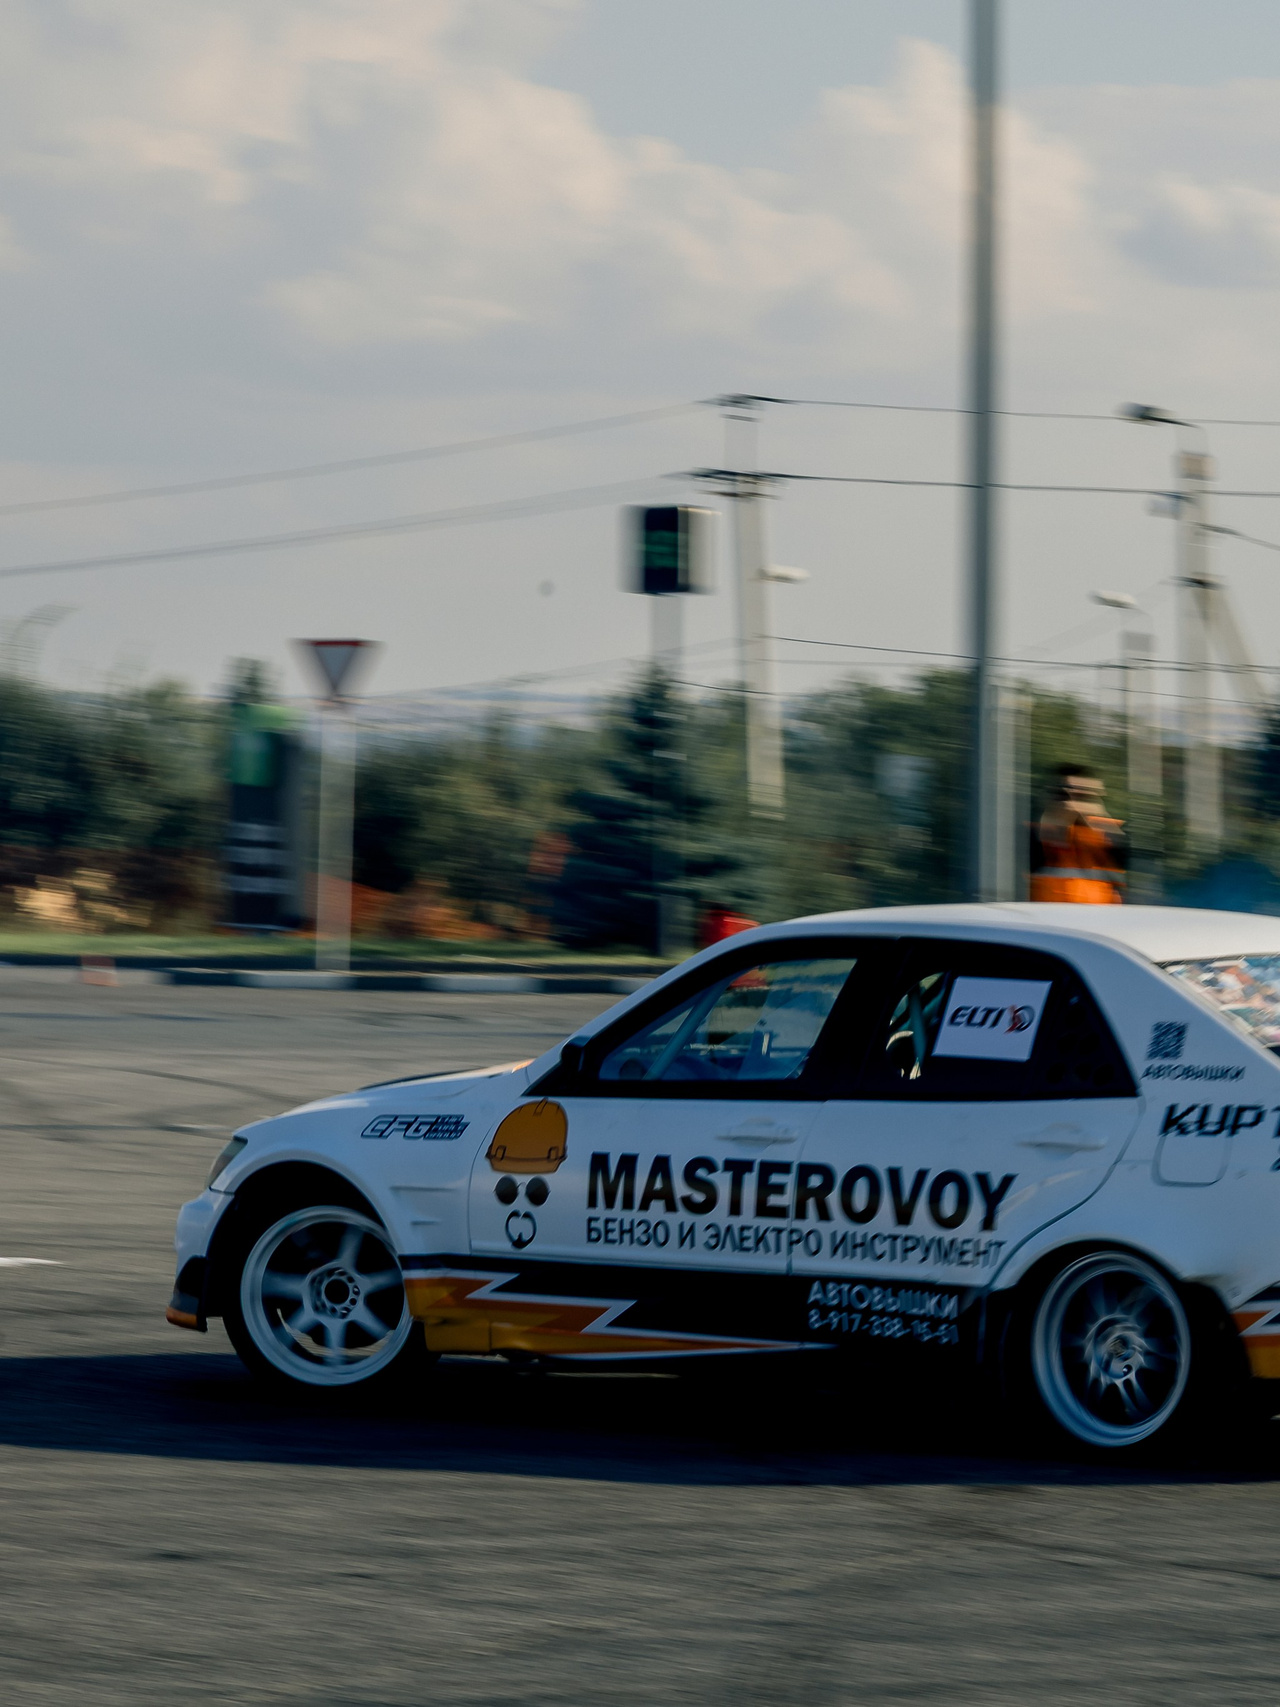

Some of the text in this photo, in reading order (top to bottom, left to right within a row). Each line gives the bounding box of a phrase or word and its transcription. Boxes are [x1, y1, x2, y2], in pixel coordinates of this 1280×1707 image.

[1140, 1063, 1245, 1082] АВТОВЫШКИ
[587, 1151, 1018, 1231] MASTEROVOY
[586, 1217, 1007, 1268] БЕНЗО И ЭЛЕКТРО ИНСТРУМЕНТ
[807, 1280, 959, 1320] АВТОВЫШКИ
